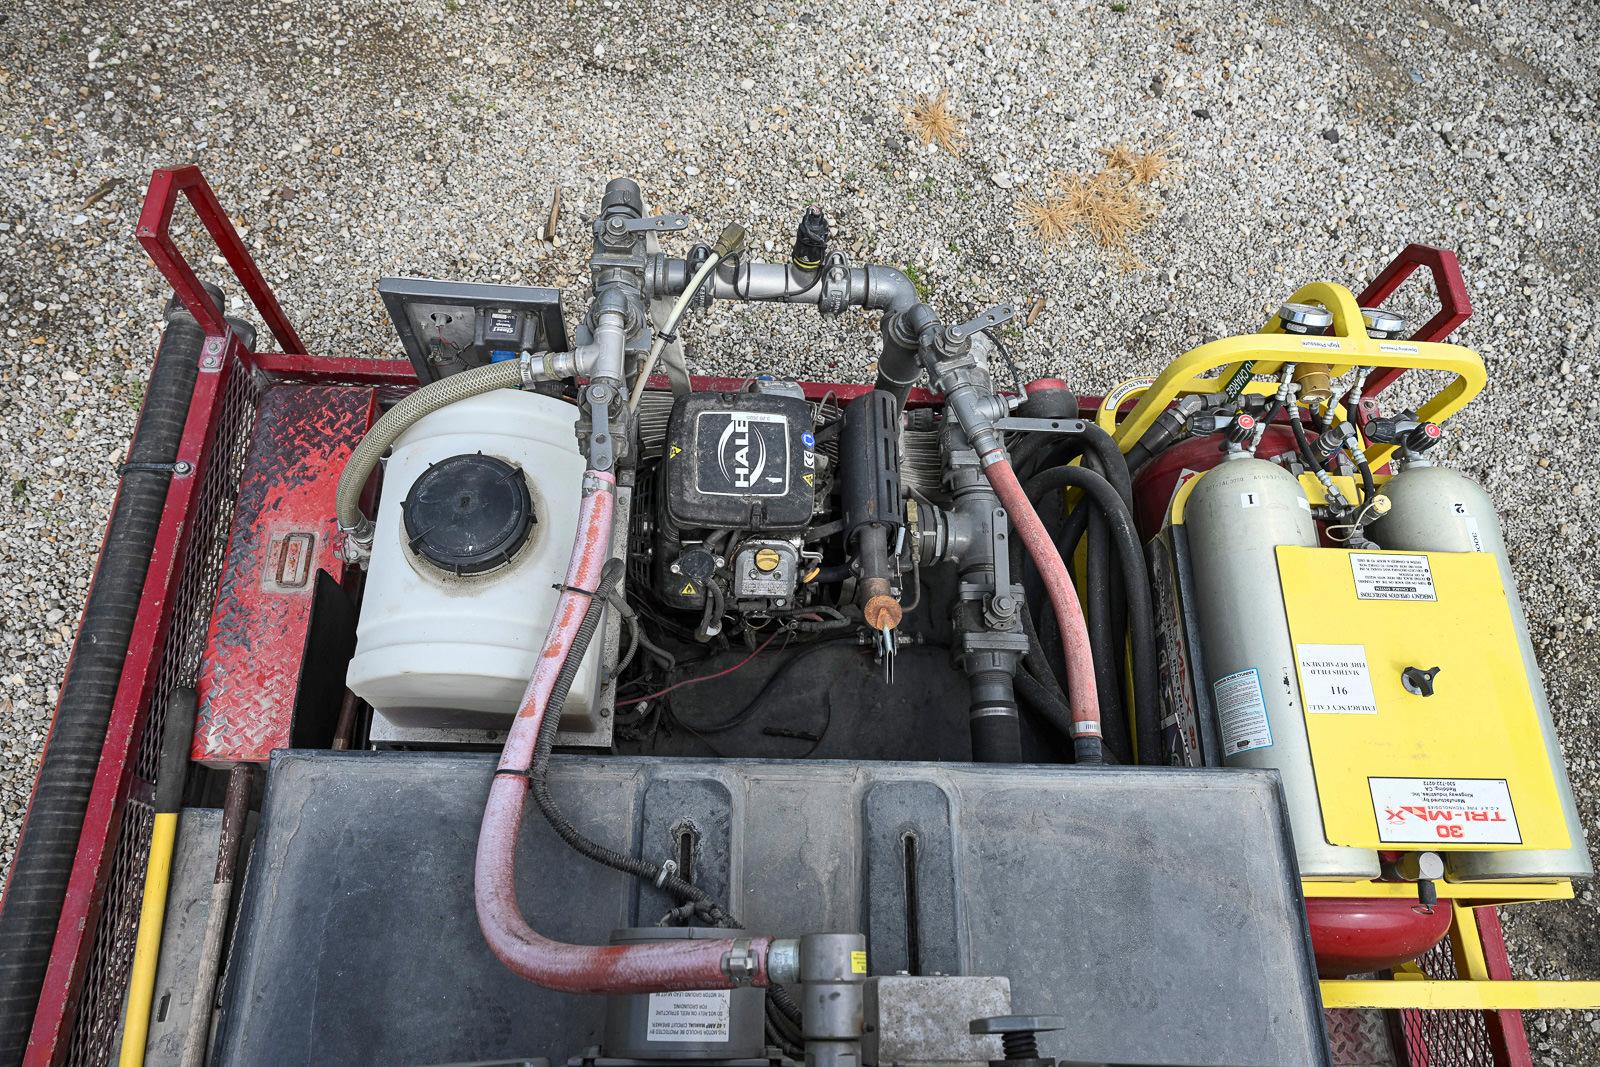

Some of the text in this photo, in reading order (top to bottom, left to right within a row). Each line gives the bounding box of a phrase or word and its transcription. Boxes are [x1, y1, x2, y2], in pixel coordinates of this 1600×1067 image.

[1226, 369, 1249, 398] CHARGE
[735, 420, 749, 488] HALE
[1454, 504, 1464, 514] 2
[1331, 686, 1348, 696] 911
[1384, 806, 1506, 822] TRI-MAX
[1436, 824, 1463, 838] 30
